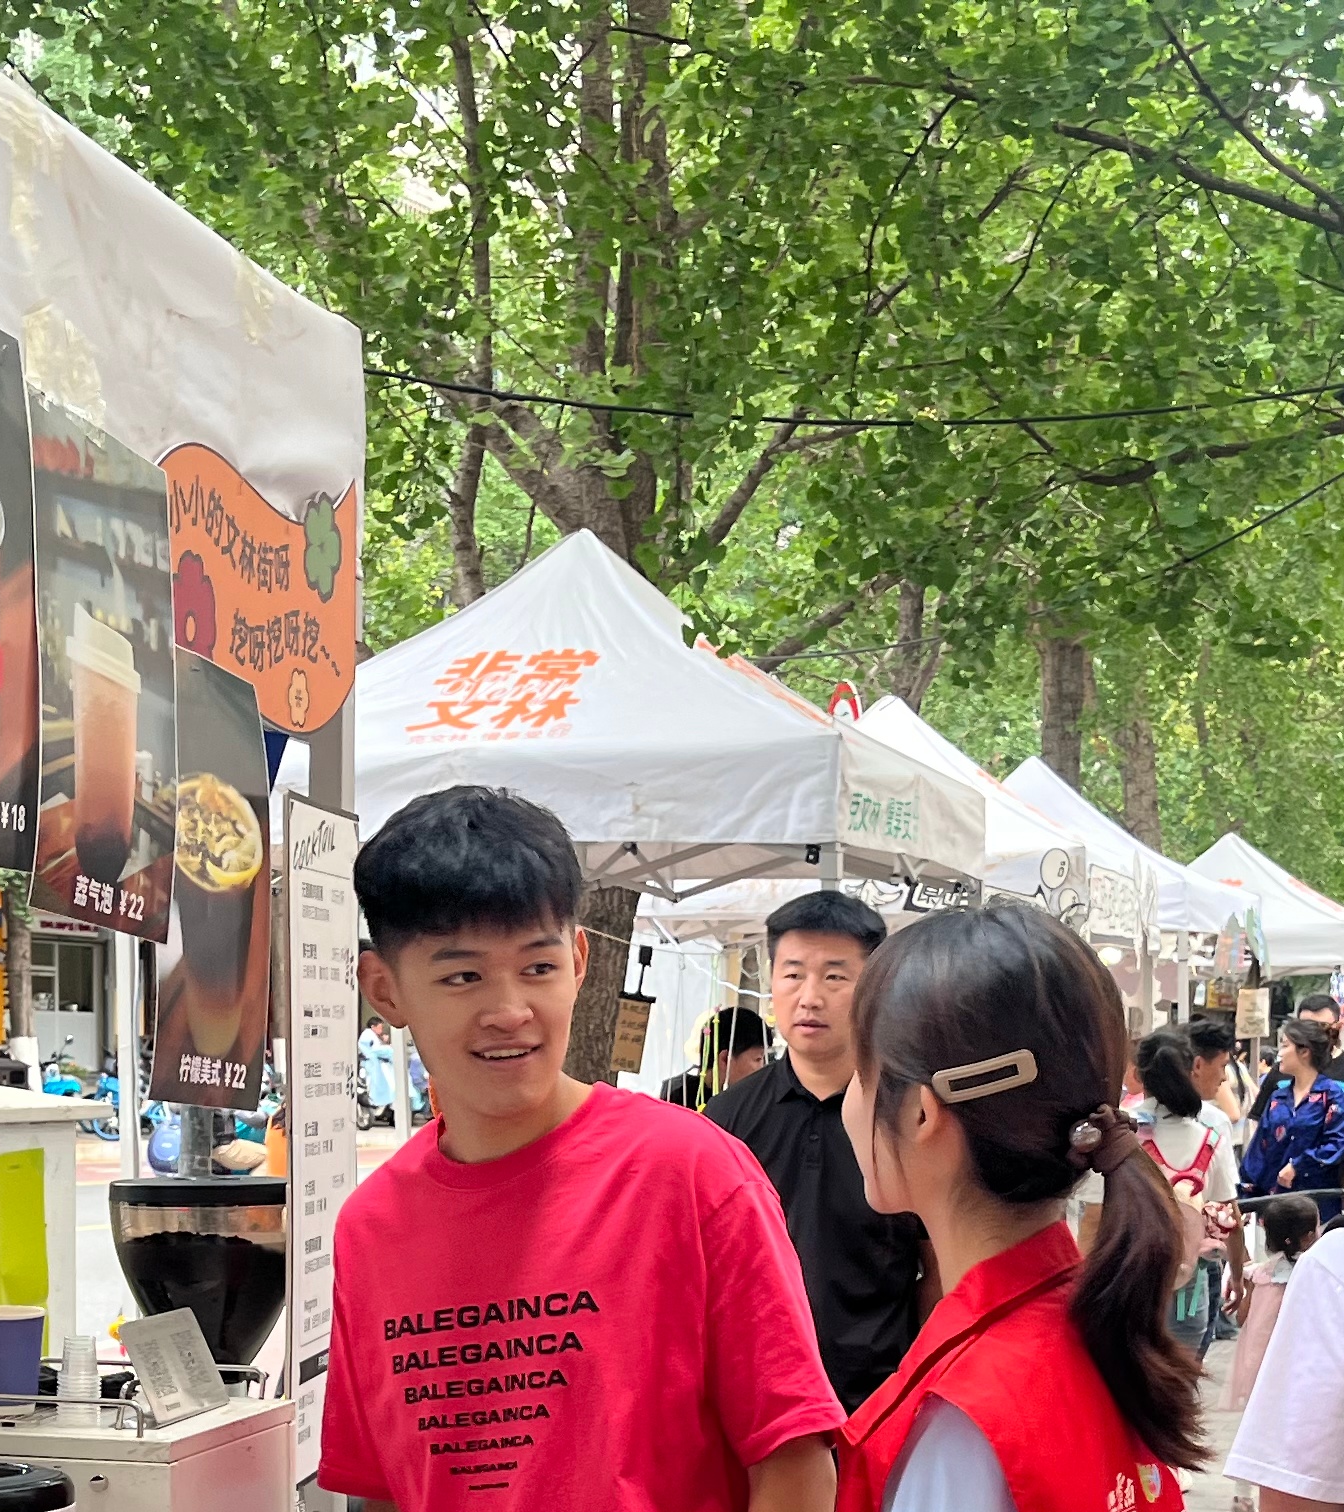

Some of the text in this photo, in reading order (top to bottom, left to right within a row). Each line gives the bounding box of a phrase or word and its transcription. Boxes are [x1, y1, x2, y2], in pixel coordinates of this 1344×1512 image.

[170, 475, 290, 593] 小小的文林街呀
[433, 648, 601, 686] 非常
[405, 690, 582, 732] 文林
[0, 802, 26, 833] ¥18
[73, 874, 144, 921] 荔气泡 ¥22
[179, 1053, 247, 1090] 柠檬美式 ¥22
[384, 1290, 600, 1342] BALEGAINCA
[392, 1331, 584, 1374] BALEGAINCA
[404, 1369, 568, 1404] BALEGAINCA
[417, 1403, 550, 1431] BALEGAINCA
